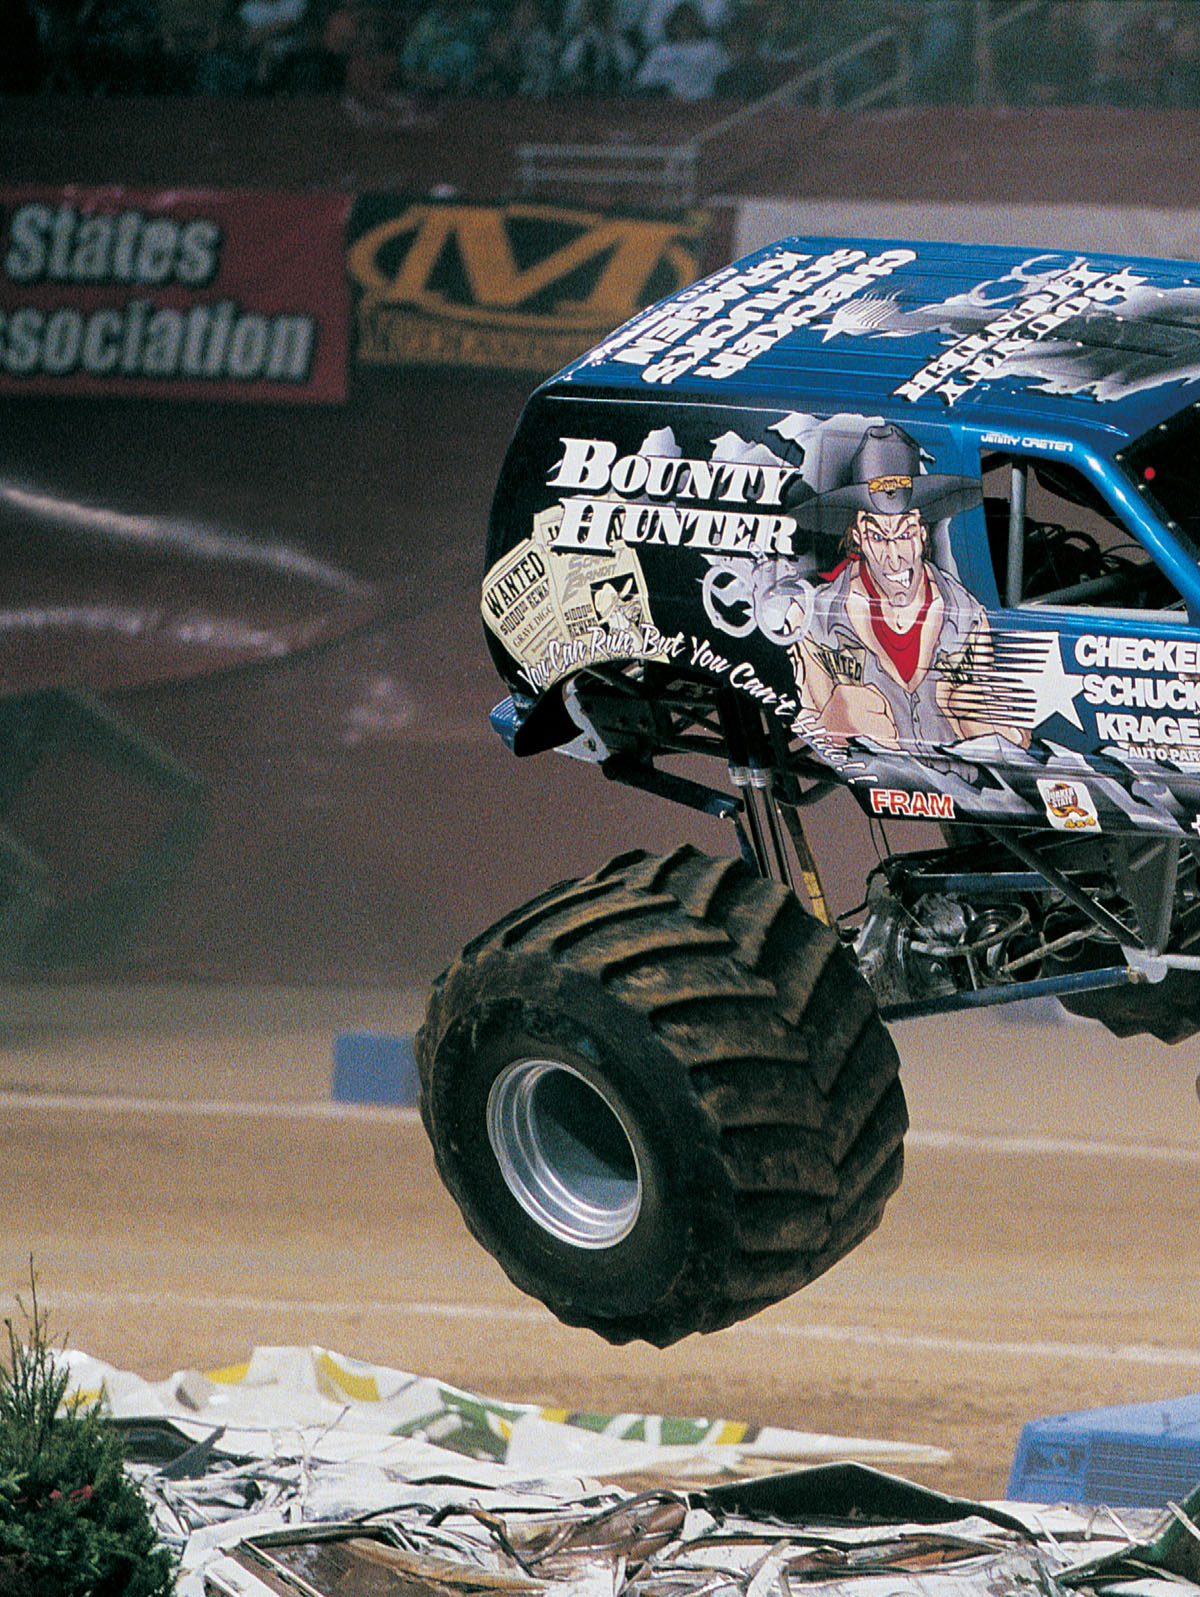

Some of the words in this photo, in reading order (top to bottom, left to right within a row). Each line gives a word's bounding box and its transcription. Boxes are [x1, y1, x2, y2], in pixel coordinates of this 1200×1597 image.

[4, 202, 222, 284] States
[546, 437, 800, 506] BOUNTY
[548, 497, 799, 556] HUNTER
[484, 551, 546, 620] WANTED
[516, 660, 550, 696] You
[549, 639, 586, 674] Can
[641, 623, 688, 659] But
[689, 635, 732, 674] You
[729, 661, 797, 717] Can't
[1128, 746, 1169, 761] AUTO
[869, 787, 956, 819] FRAM
